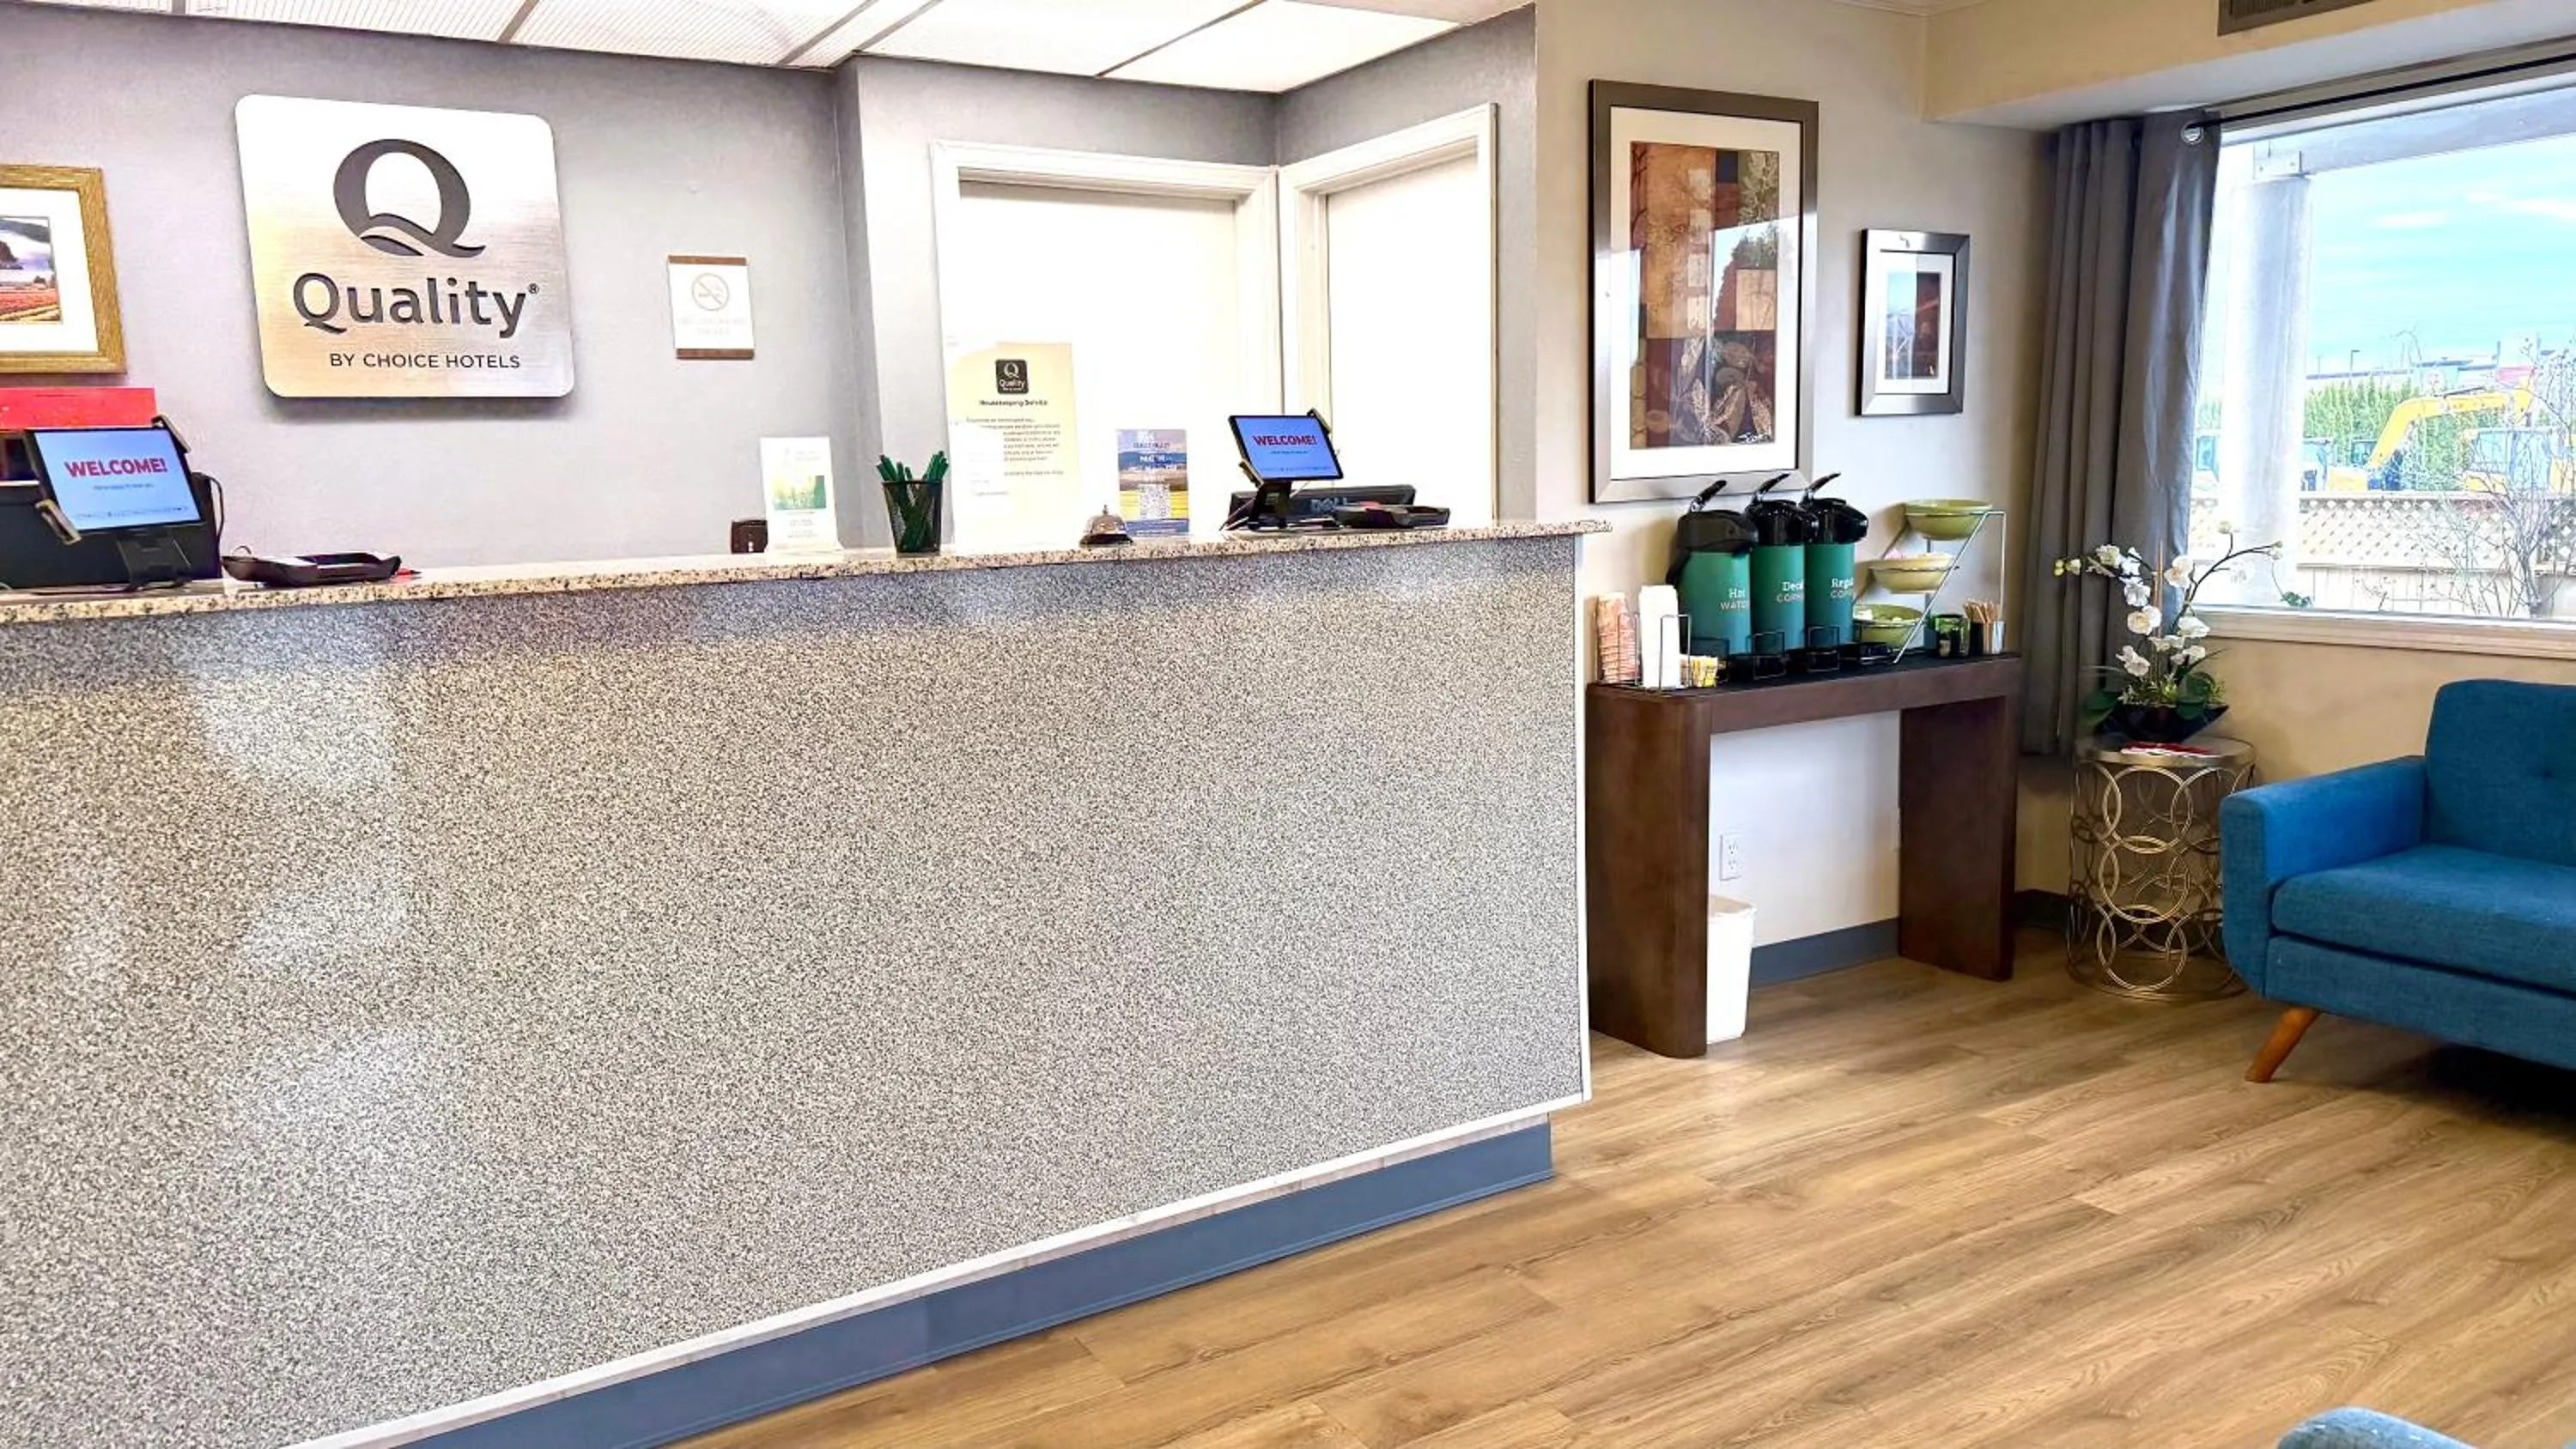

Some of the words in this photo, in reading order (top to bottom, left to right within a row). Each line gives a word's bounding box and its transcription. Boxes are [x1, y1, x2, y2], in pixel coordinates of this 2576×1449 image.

[332, 138, 487, 258] Q
[330, 353, 355, 367] BY
[363, 353, 440, 368] CHOICE
[446, 355, 520, 369] HOTELS
[1252, 434, 1318, 446] WELCOME!
[64, 458, 167, 477] WELCOME!
